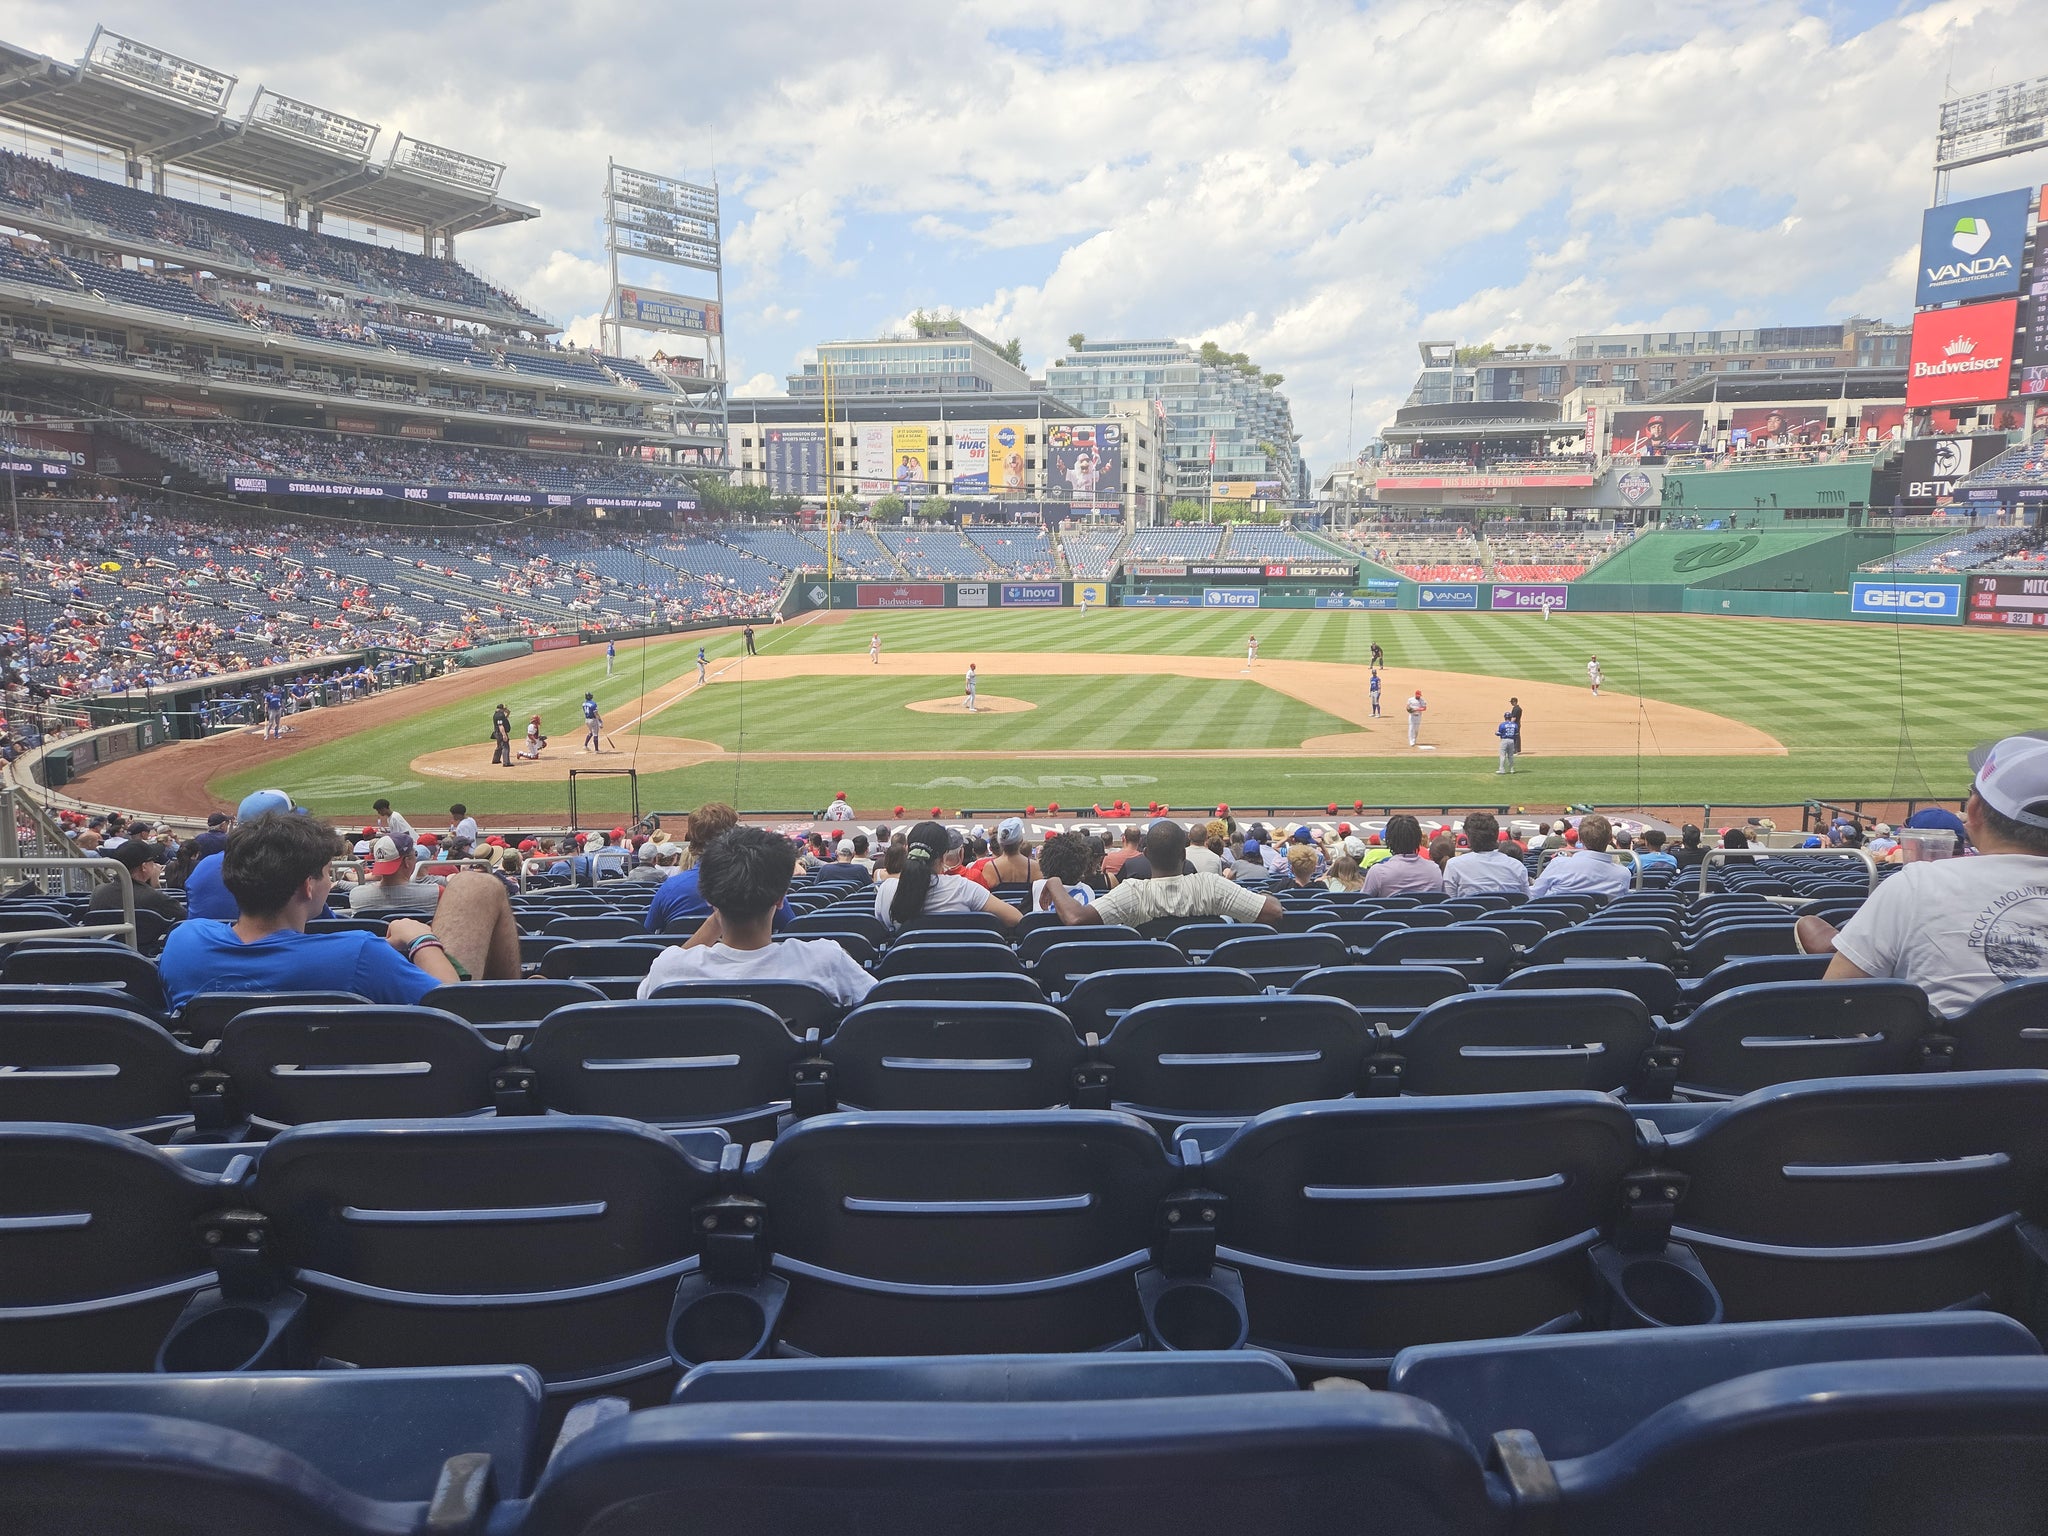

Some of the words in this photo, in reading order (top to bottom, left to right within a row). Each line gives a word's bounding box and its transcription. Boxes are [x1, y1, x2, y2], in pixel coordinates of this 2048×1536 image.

[1927, 255, 2012, 280] VANDA
[1929, 273, 1994, 287] PHARMACEUTICALS
[643, 303, 670, 315] BEAUTIFUL
[672, 307, 688, 318] VIEWS
[689, 311, 700, 320] AND
[641, 312, 660, 322] AWARD
[661, 315, 685, 326] WINNING
[685, 318, 703, 329] BREWS
[1914, 357, 2003, 377] Budweiser
[959, 441, 986, 449] HVAC
[1441, 478, 1459, 487] THIS
[1462, 478, 1486, 486] BUD'S
[1488, 477, 1504, 486] FOR
[1506, 477, 1525, 486] YOU.
[289, 483, 324, 493] STREAM
[326, 485, 331, 493] &
[333, 485, 352, 494] STAY
[353, 487, 383, 496] AHEAD
[448, 491, 478, 500] STREAM
[485, 493, 503, 501] STAY
[504, 494, 531, 502] AHEAD
[587, 498, 614, 506] STREAM
[1139, 566, 1160, 574] Harris
[1162, 566, 1184, 574] Teeter
[1321, 567, 1349, 575] FAN
[1979, 578, 1997, 591] #70
[1023, 588, 1055, 597] Inova
[1222, 593, 1255, 604] Terra
[1516, 592, 1563, 605] leidos
[1864, 590, 1945, 608] GEICO
[2013, 613, 2028, 623] 32.1
[890, 774, 1158, 788] AARP
[1968, 906, 1995, 948] ROCKY
